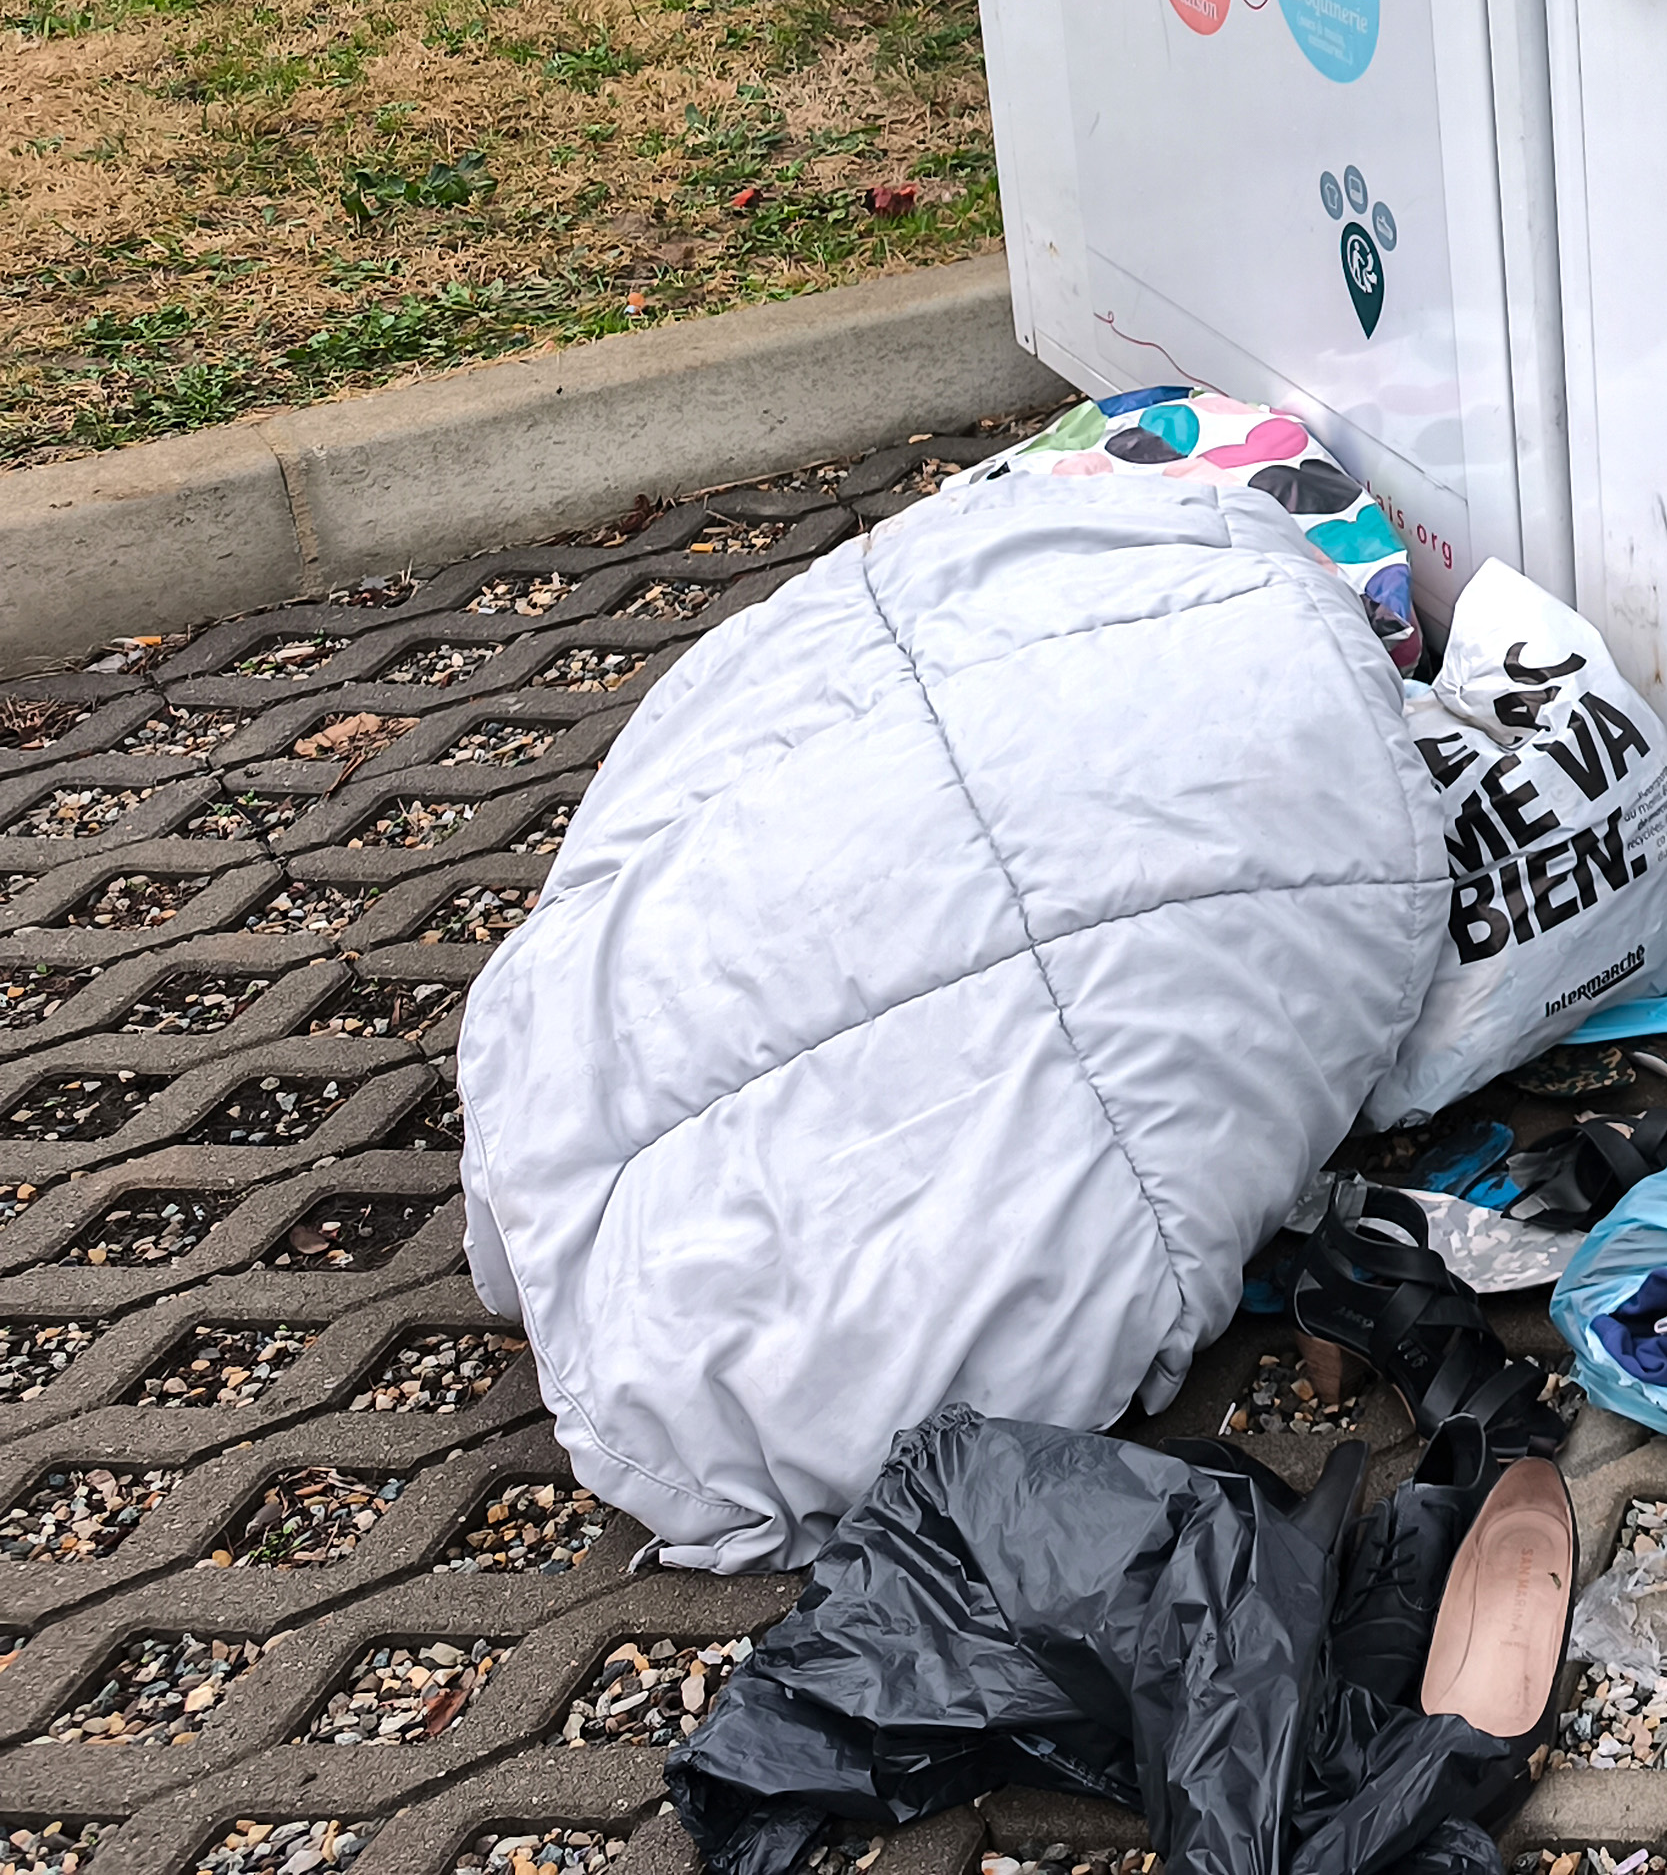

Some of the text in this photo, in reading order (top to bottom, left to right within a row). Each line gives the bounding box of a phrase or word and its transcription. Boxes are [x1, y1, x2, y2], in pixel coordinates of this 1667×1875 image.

[1444, 753, 1561, 880] ME
[1532, 691, 1651, 802] VA
[1448, 806, 1648, 966] BIEN.
[1519, 1548, 1534, 1575] SAN
